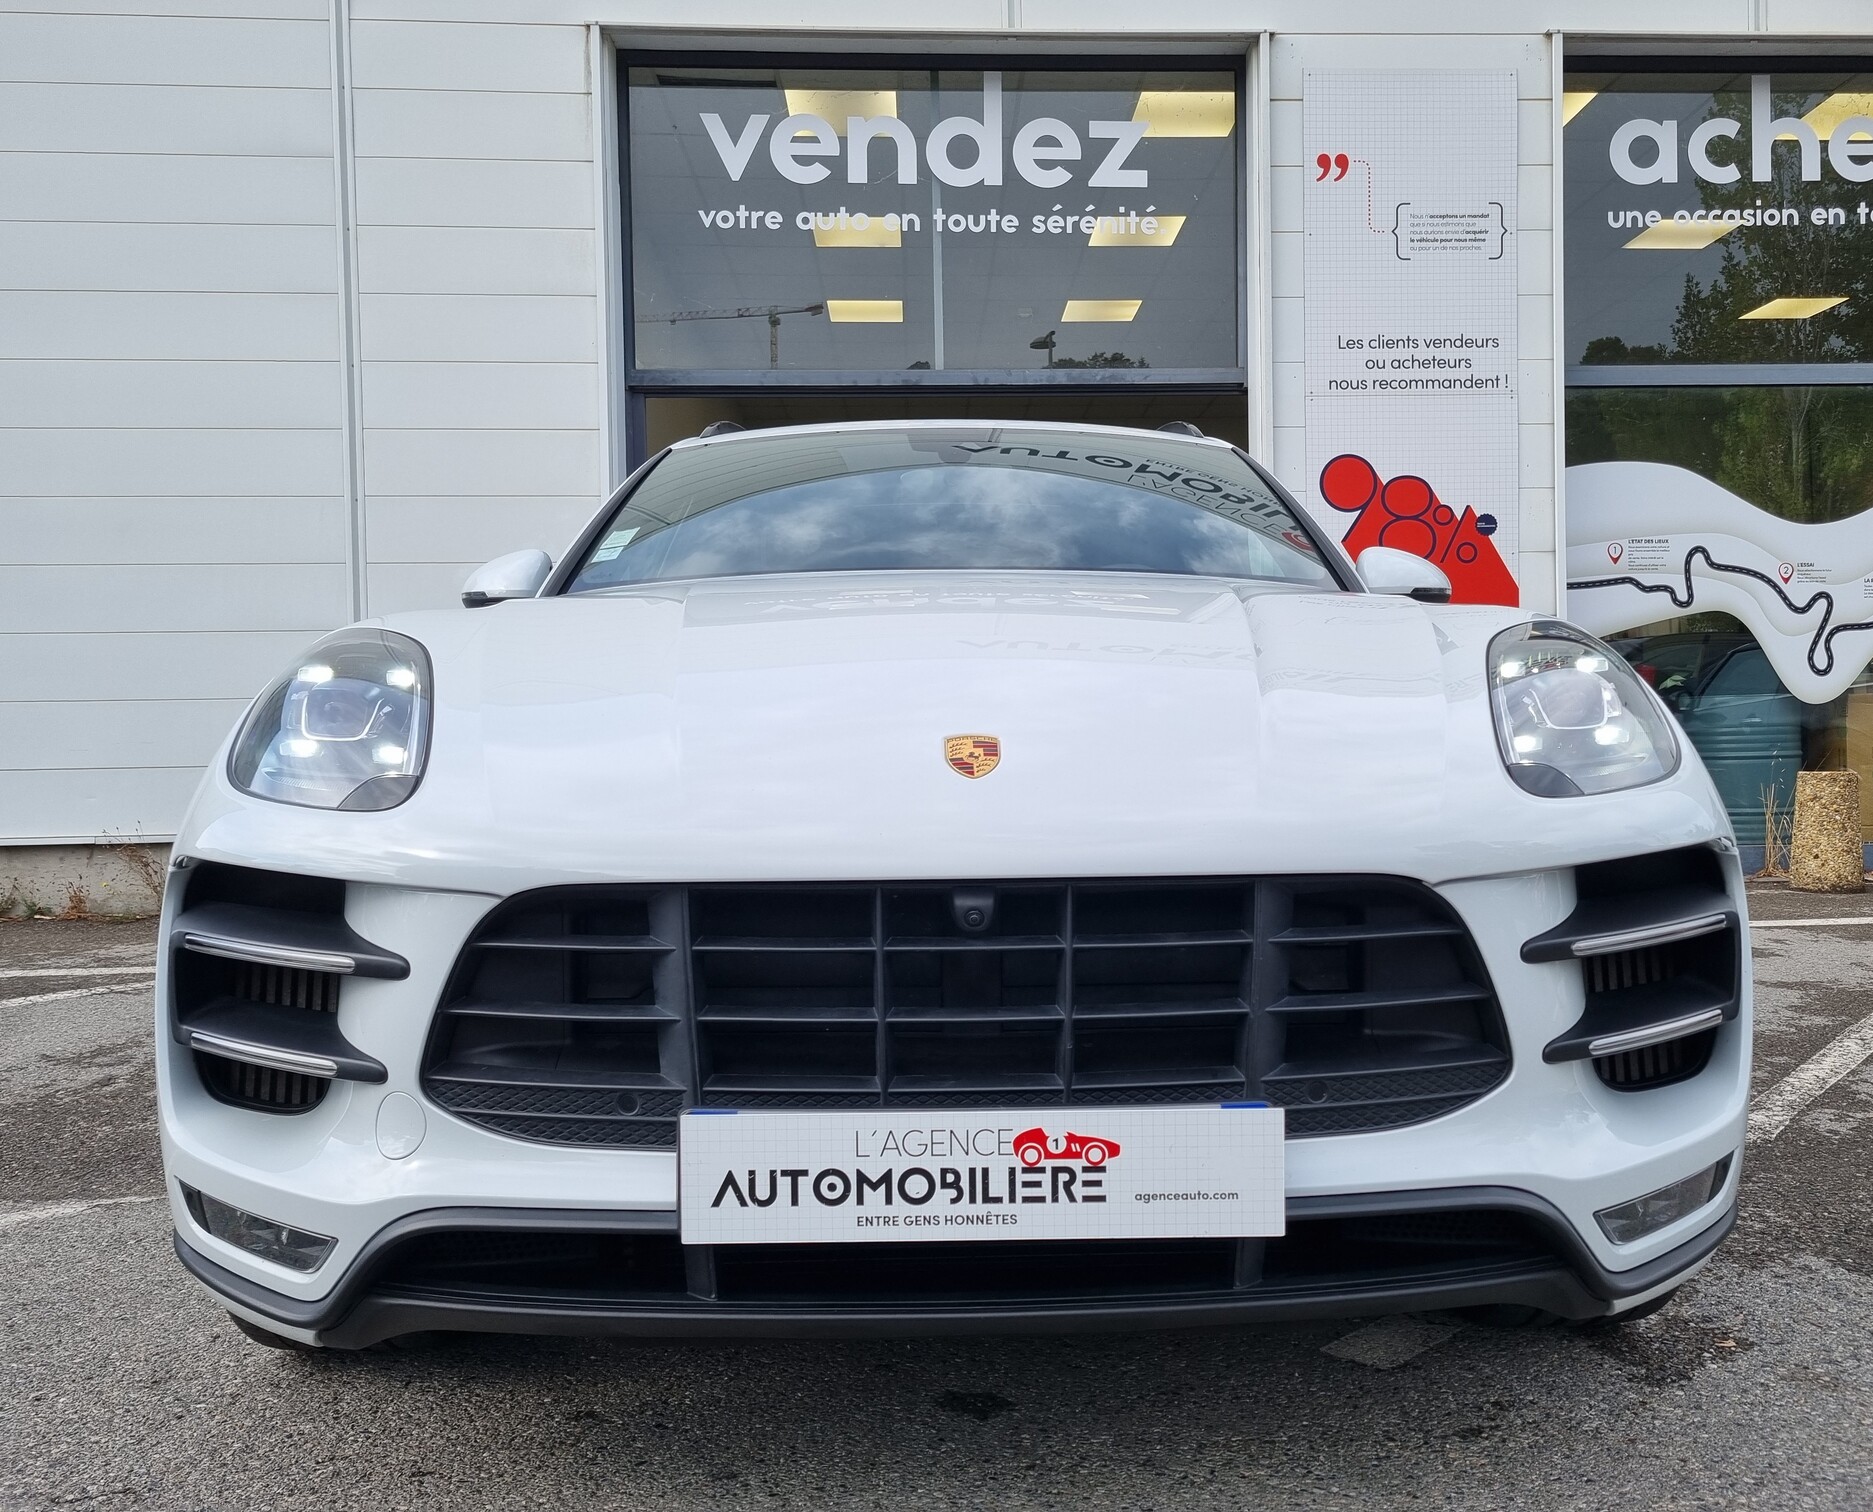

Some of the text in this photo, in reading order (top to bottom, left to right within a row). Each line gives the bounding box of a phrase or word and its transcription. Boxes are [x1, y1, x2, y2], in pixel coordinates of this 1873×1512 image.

[699, 70, 1150, 189] vendez
[1608, 74, 1873, 186] ache
[698, 203, 1166, 237] votre auto en toute sérénité.
[1607, 199, 1873, 229] une occasion en t
[1337, 333, 1500, 350] Les clients vendeurs
[1364, 355, 1472, 370] ou acheteurs
[1328, 377, 1368, 390] nous
[1372, 374, 1502, 390] recommandent
[855, 1128, 1014, 1157] L'AGENCE
[711, 1166, 1107, 1207] AUTOMOBILIERE
[1134, 1190, 1239, 1203] agenceauto.com
[857, 1211, 1018, 1226] ENTRE GENS HONNÊTES
